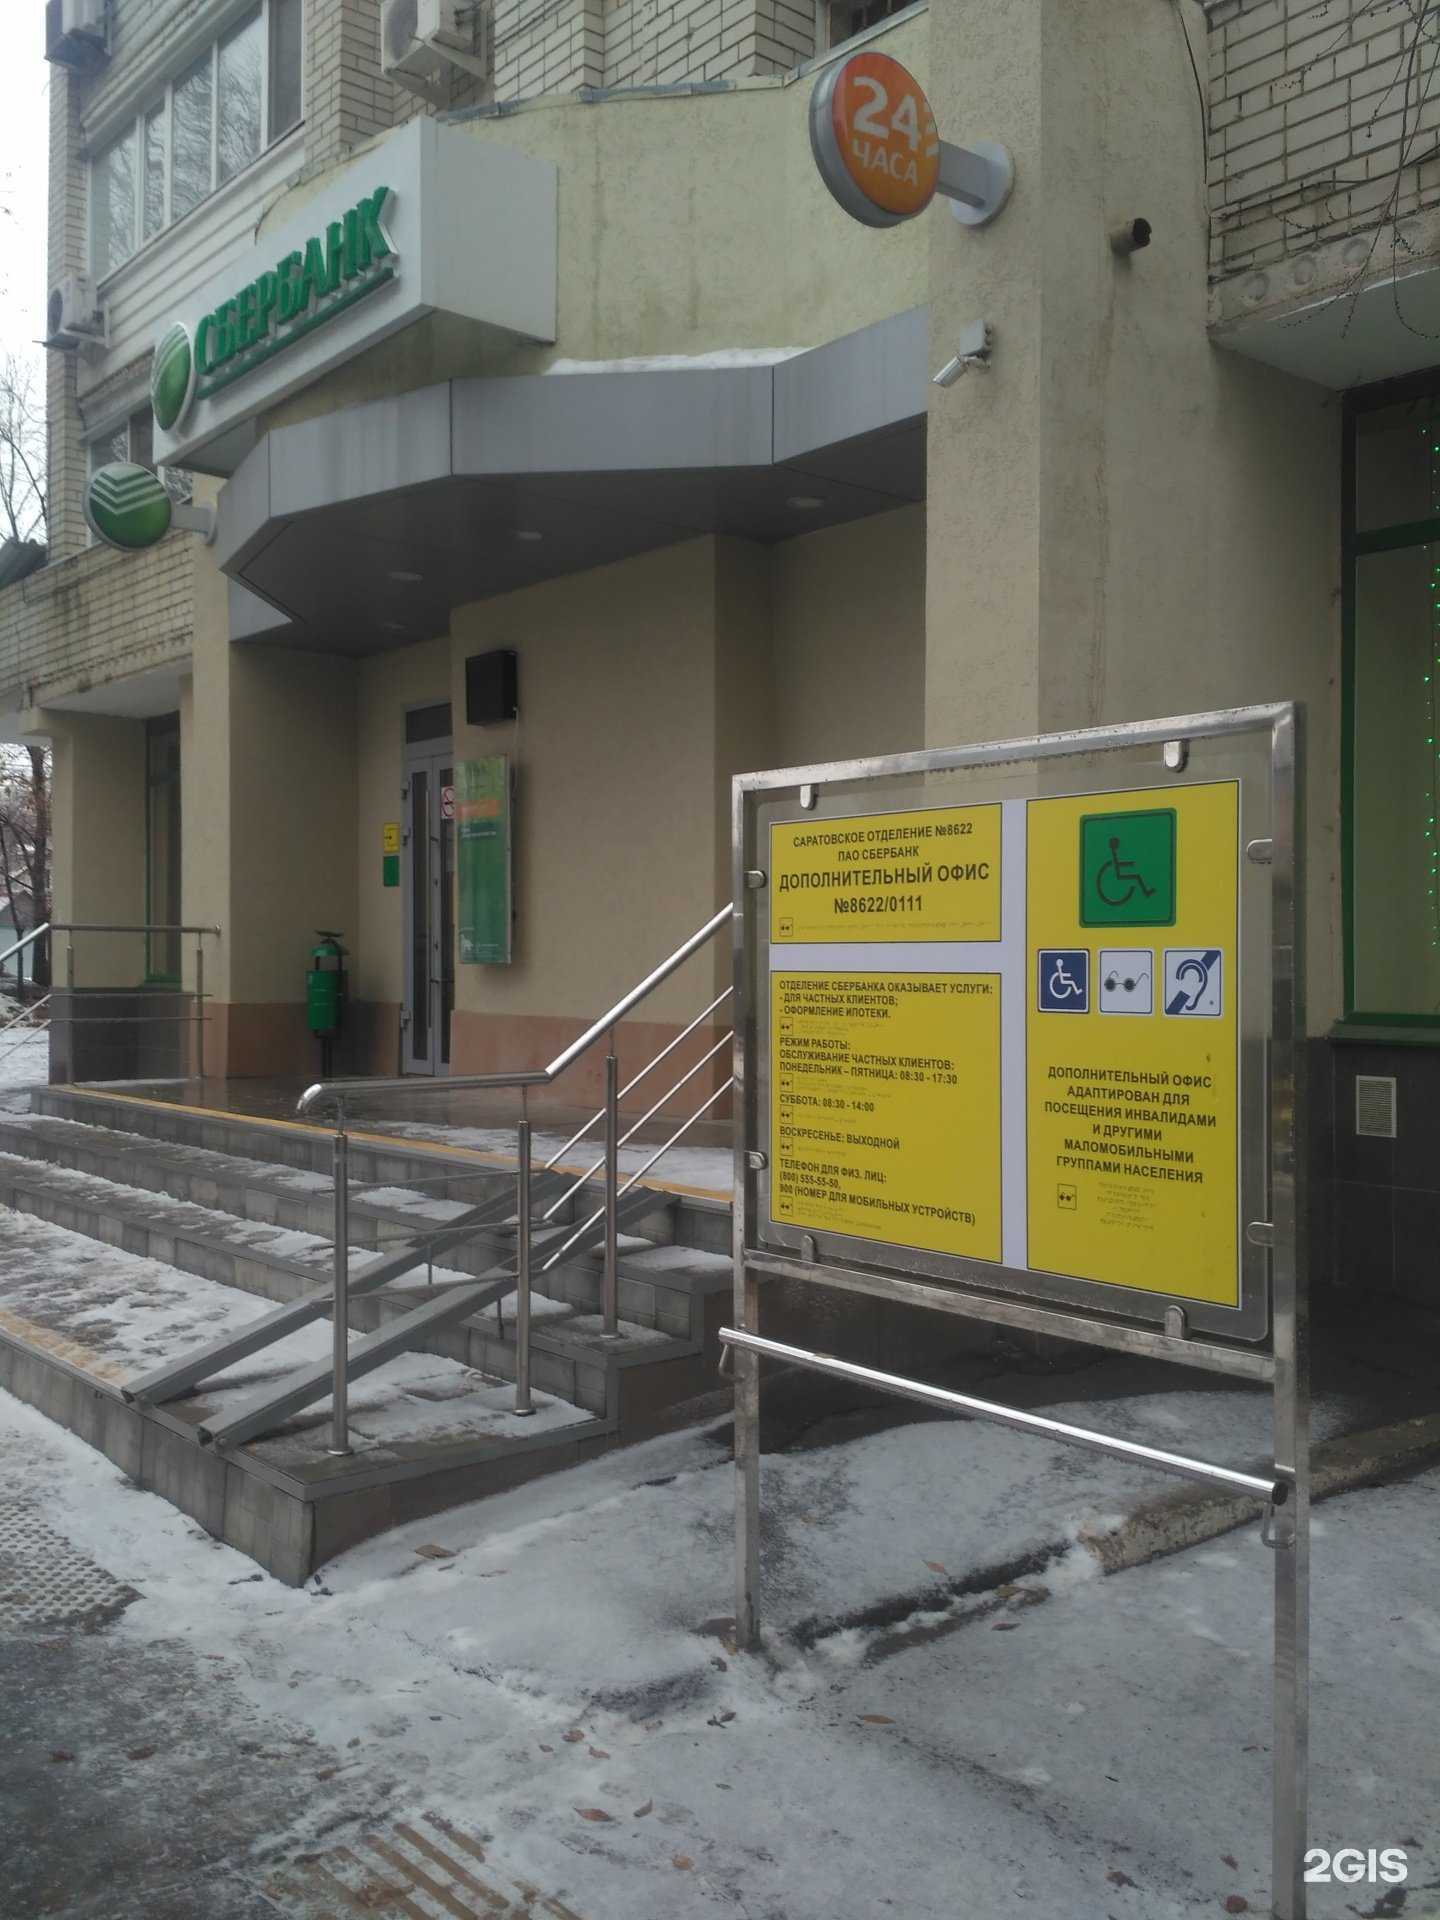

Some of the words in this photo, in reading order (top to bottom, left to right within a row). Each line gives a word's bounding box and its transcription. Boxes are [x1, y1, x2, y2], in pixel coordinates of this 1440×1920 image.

[853, 76, 921, 151] 24
[852, 138, 919, 187] ЧАСА
[194, 186, 398, 376] СБЕРБАНК
[793, 831, 865, 848] САРАТОВСКОЕ
[867, 825, 932, 842] ОТДЕЛЕНИЕ
[935, 822, 973, 836] №8622
[838, 849, 860, 862] ПАО
[862, 846, 920, 860] СБЕРБАНК
[779, 862, 932, 892] ДОПОЛНИТЕЛЬНЫЙ
[937, 863, 990, 882] ОФИС
[834, 895, 923, 914] №8622/0111
[779, 980, 829, 991] ОТДЕЛЕНИЕ
[832, 981, 885, 992] СБЕРБАНКА
[887, 982, 947, 994] ОКАЗЫВАЕТ
[950, 983, 993, 995] УСЛУГИ:
[784, 993, 801, 1003] ДЛЯ
[803, 993, 845, 1004] ЧАСТНЫХ
[784, 1005, 844, 1017] ОФОРМЛЕНИЕ
[846, 1008, 891, 1018] ИПОТЕКИ.
[779, 1037, 809, 1047] РЕЖИМ
[811, 1038, 850, 1050] РАБОТЫ:
[779, 1050, 850, 1063] ОБСЛУЖИВАНИЕ
[852, 1054, 896, 1066] ЧАСТНЫХ
[779, 1061, 843, 1075] ПОНЕДЕЛЬНИК
[851, 1066, 898, 1080] ПЯТНИЦА:
[900, 1071, 924, 1081] 08:30
[933, 1073, 957, 1085] 17:30
[1048, 1066, 1169, 1086] ДОПОЛНИТЕЛЬНЫЙ
[1172, 1074, 1212, 1088] ОФИС
[779, 1094, 821, 1106] СУББОТА:
[822, 1098, 845, 1109] 08:30
[852, 1101, 874, 1112] 14:00
[1067, 1085, 1160, 1103] АДАПТИРОВАН
[1163, 1093, 1190, 1106] ДЛЯ
[1045, 1101, 1122, 1119] ПОСЕЩЕНИЯ
[1125, 1108, 1217, 1127] ИНВАЛИДАМИ
[779, 1126, 845, 1143] ВОСКРЕСЕНЬЕ:
[846, 1133, 901, 1149] ВЫХОДНОЙ
[1092, 1123, 1101, 1135] И
[1103, 1124, 1162, 1141] ДРУГИМИ
[1064, 1139, 1194, 1164] МАЛОМОБИЛЬНЫМИ
[780, 1158, 820, 1172] ТЕЛЕФОН
[820, 1163, 839, 1175] ДЛЯ
[840, 1167, 863, 1178] ФИЗ.
[864, 1170, 887, 1184] ЛИЦ:
[1056, 1155, 1121, 1173] ГРУППАМИ
[1124, 1163, 1203, 1184] НАСЕЛЕНИЯ
[794, 1186, 827, 1199] (НОМЕР
[828, 1191, 847, 1203] ДЛЯ
[849, 1193, 911, 1213] МОБИЛЬНЫХ
[912, 1203, 976, 1226] УСТРОЙСТВ)
